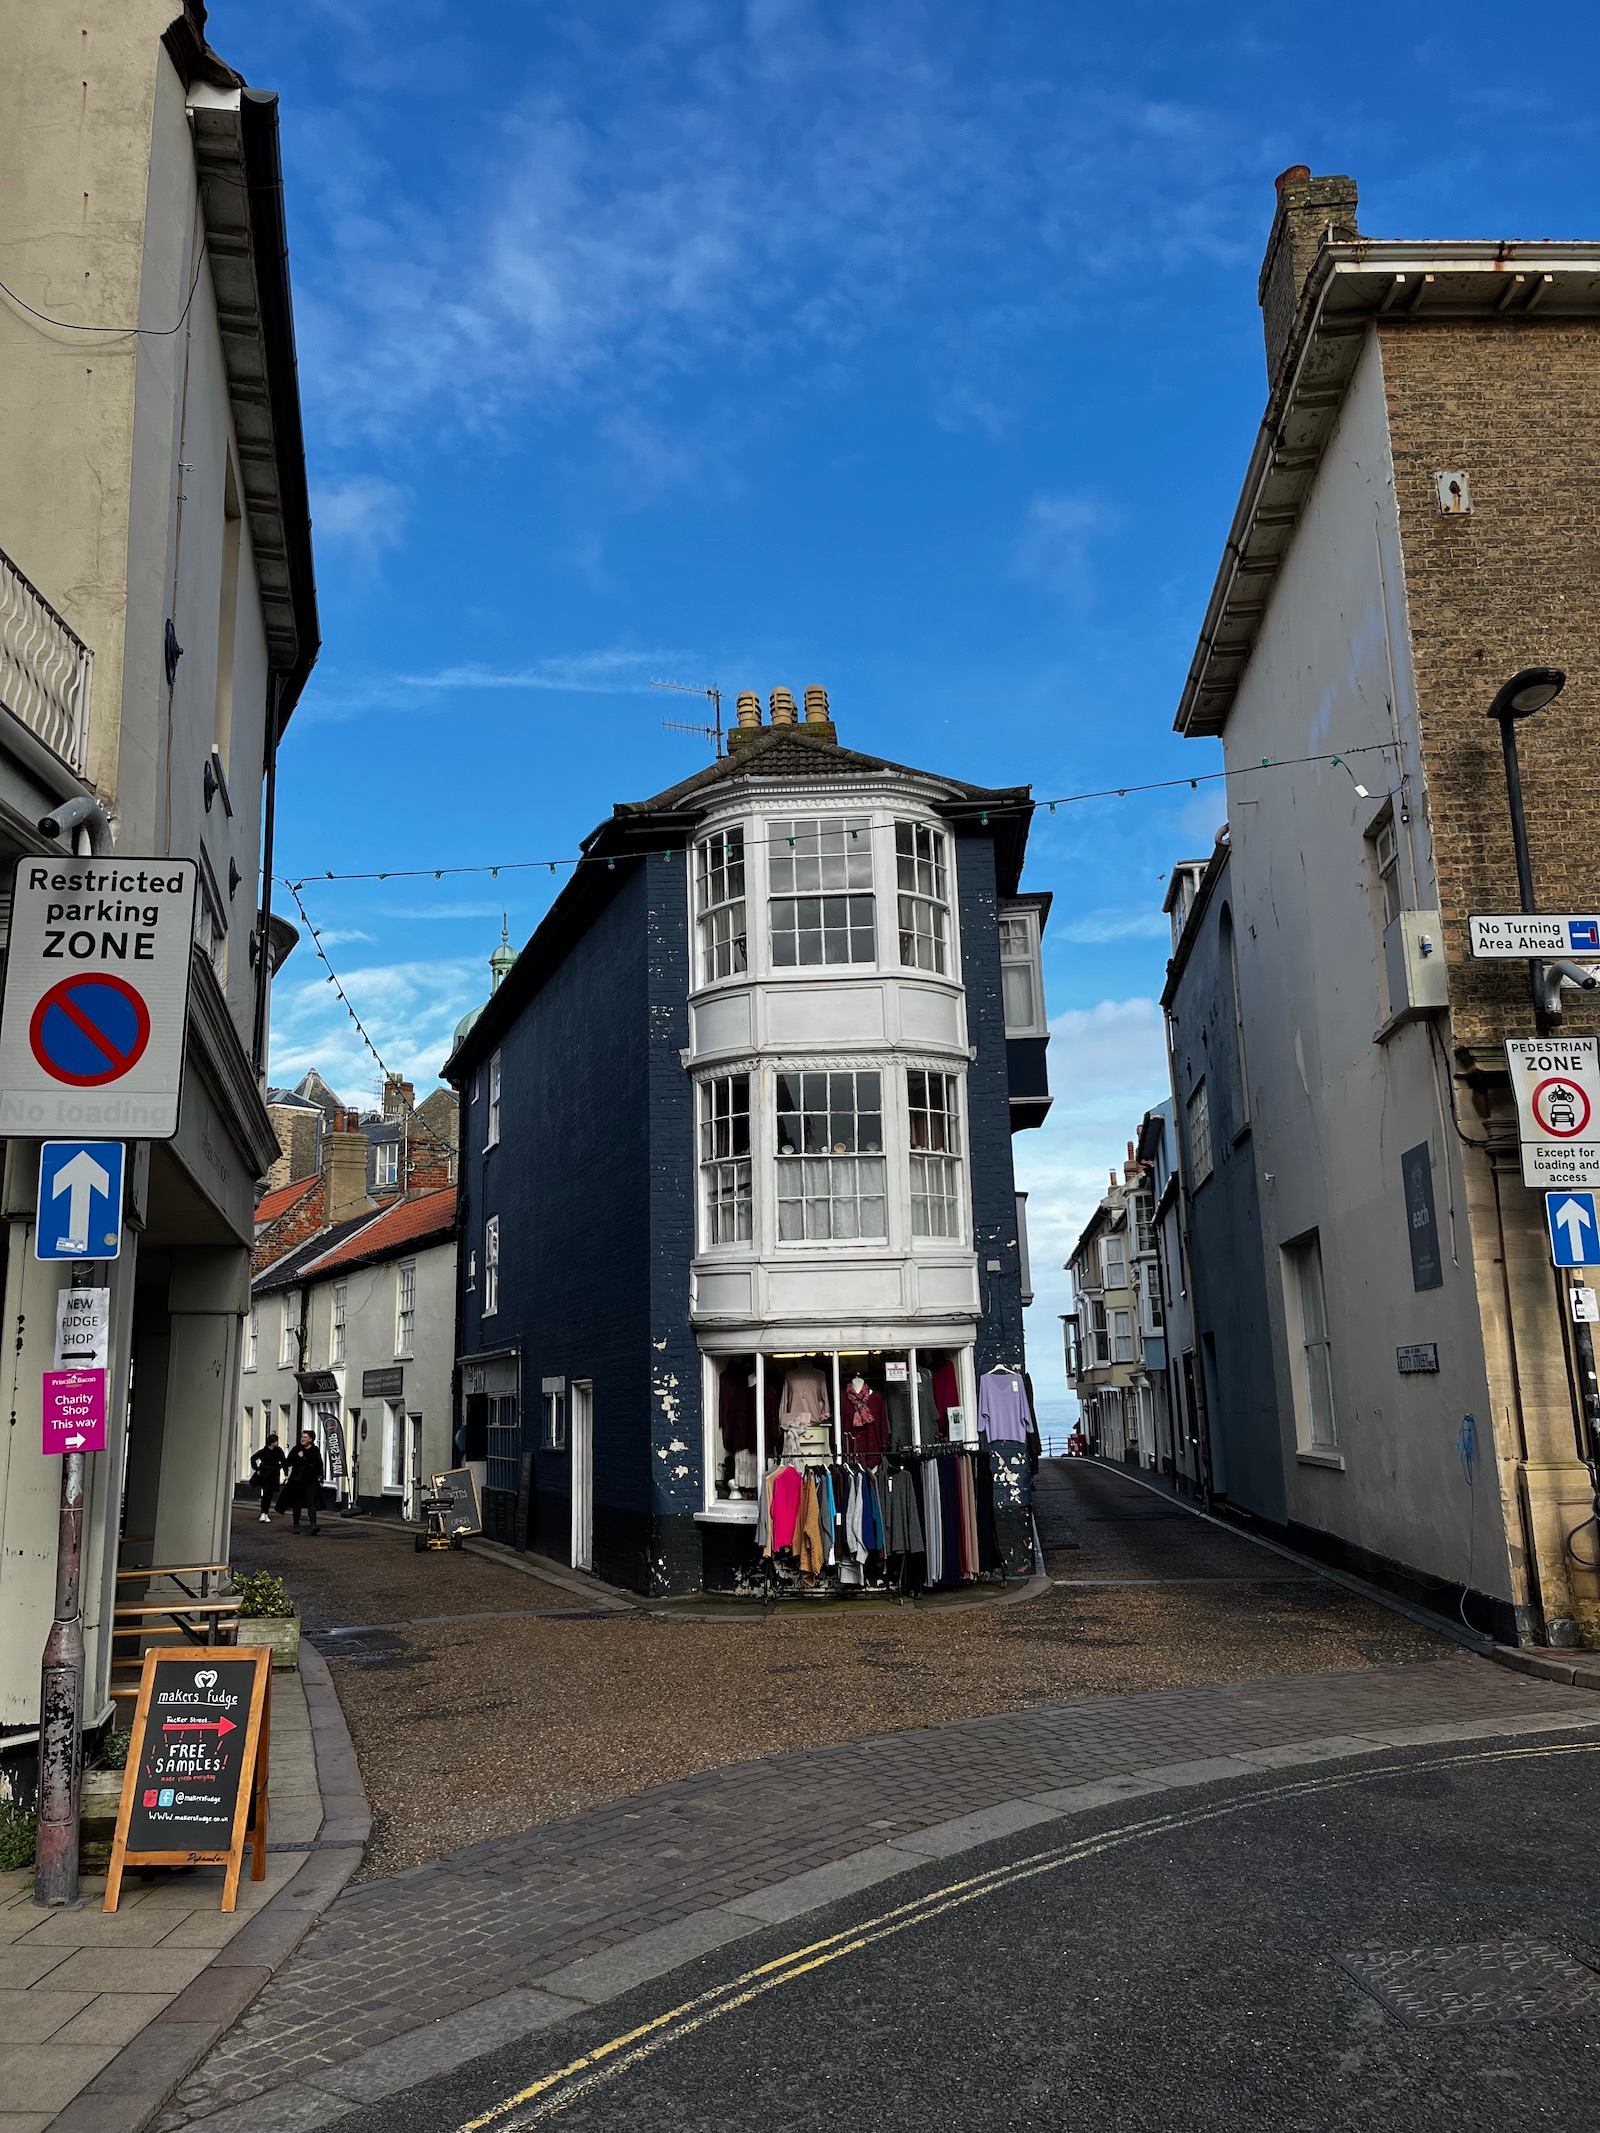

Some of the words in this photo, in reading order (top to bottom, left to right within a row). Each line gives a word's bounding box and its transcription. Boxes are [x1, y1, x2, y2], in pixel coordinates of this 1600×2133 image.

[29, 868, 184, 893] Restricted
[46, 900, 159, 926] parking
[1479, 922, 1499, 934] No
[1504, 922, 1560, 935] Turning
[42, 930, 155, 960] ZONE
[1479, 937, 1513, 949] Area
[1519, 937, 1564, 949] Ahead
[1511, 1042, 1592, 1052] PEDESTRIAN
[1525, 1056, 1583, 1071] ZONE
[2, 1099, 45, 1123] No
[57, 1100, 168, 1128] loading
[1536, 1148, 1575, 1158] Except
[1579, 1148, 1595, 1157] for
[1534, 1160, 1575, 1171] loading
[1579, 1160, 1600, 1170] and
[1549, 1174, 1587, 1182] access
[67, 1298, 94, 1310] NEW
[62, 1316, 98, 1328] FUDGE
[63, 1333, 94, 1345] SHOP
[55, 1394, 93, 1406] Charity
[62, 1405, 89, 1416] Shop
[51, 1419, 73, 1430] This
[76, 1418, 97, 1428] way
[207, 1689, 238, 1710] fudge
[169, 1743, 207, 1758] FREE
